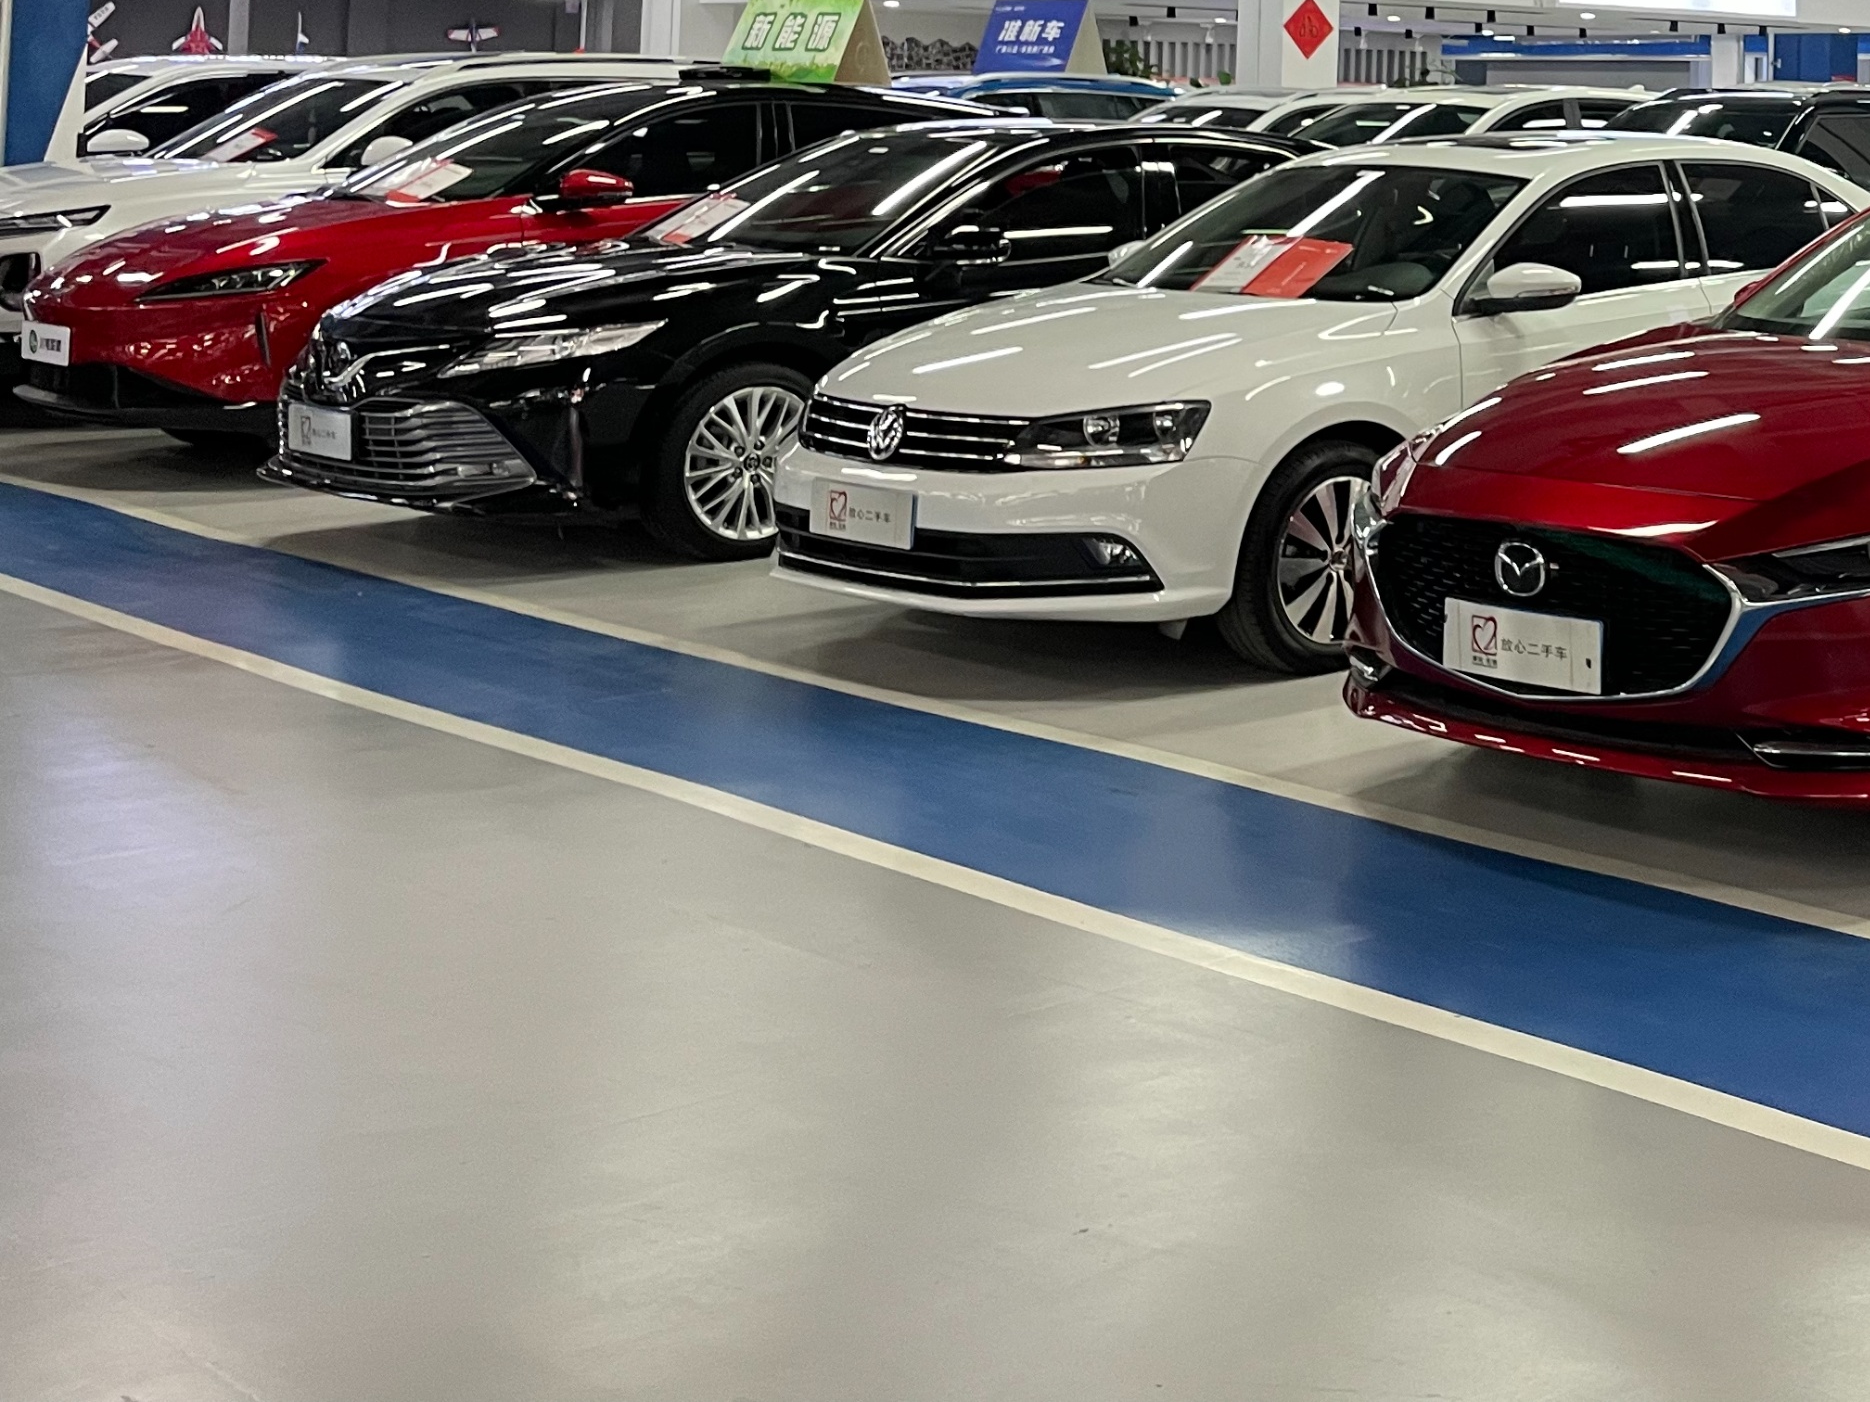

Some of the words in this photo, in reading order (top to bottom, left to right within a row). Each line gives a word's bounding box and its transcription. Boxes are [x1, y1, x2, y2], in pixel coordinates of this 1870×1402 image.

[742, 11, 842, 52] 新能源
[1501, 637, 1568, 660] 放心二手车
